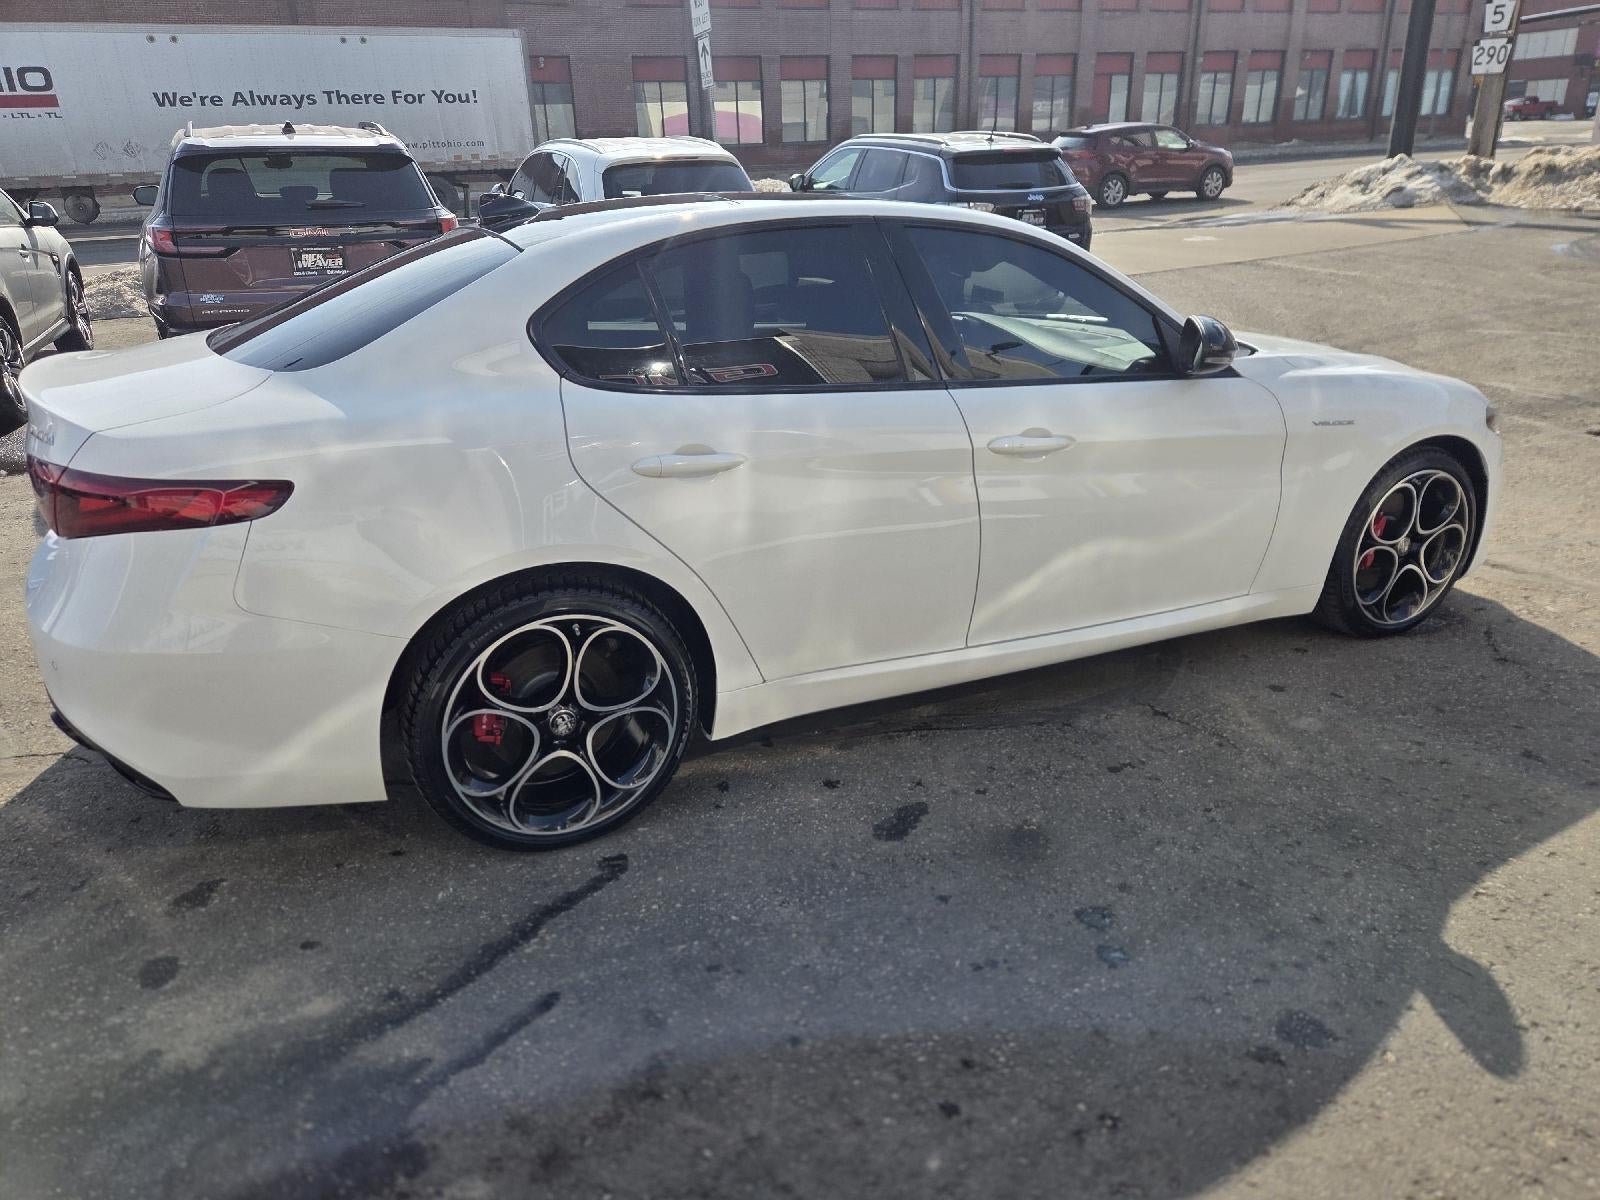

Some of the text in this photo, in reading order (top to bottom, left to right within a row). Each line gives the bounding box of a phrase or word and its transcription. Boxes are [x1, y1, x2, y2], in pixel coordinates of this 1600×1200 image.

[1491, 4, 1506, 24] 5
[1473, 44, 1508, 65] 290
[0, 66, 54, 92] IO
[152, 89, 478, 109] We're Always There For You!
[1028, 193, 1045, 202] Jeep
[297, 257, 343, 269] WEAVER
[302, 253, 324, 261] RICK
